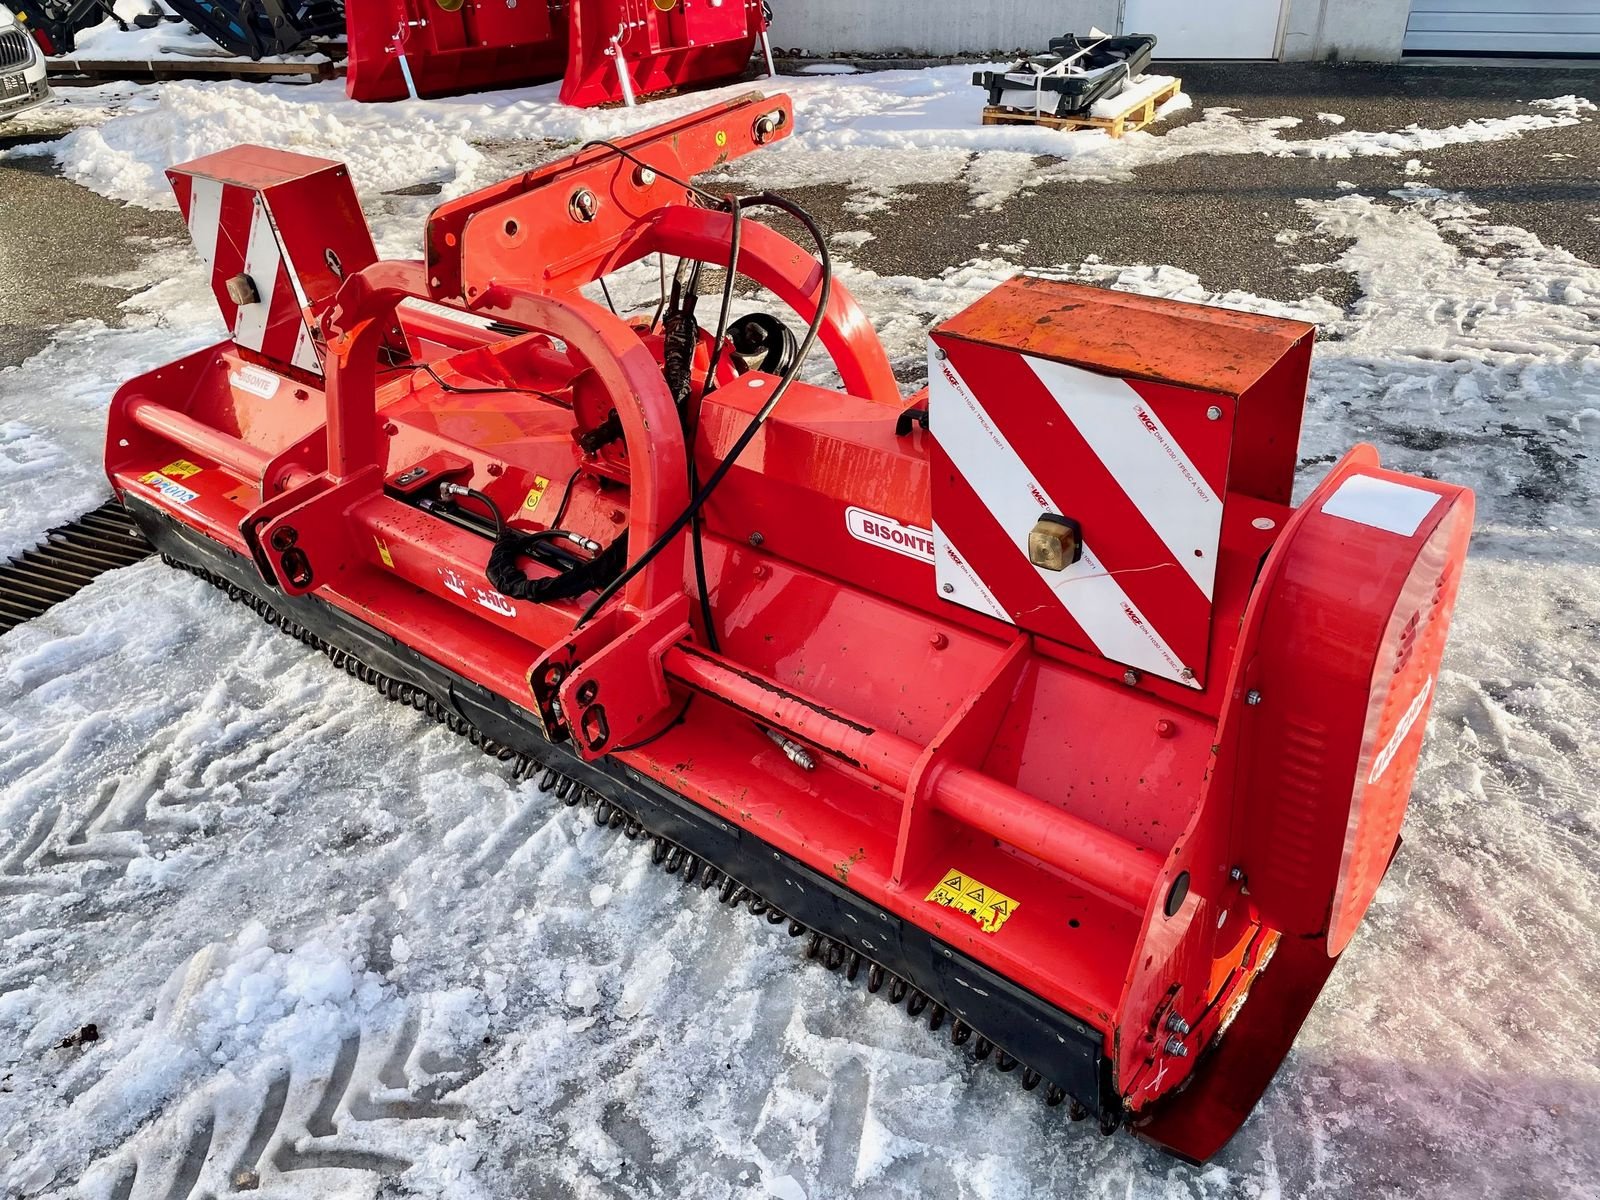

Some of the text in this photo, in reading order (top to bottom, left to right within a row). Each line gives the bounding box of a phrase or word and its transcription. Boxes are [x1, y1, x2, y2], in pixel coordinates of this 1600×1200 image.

[943, 367, 959, 387] WGF
[956, 385, 965, 396] DIN
[1138, 411, 1158, 432] WGF
[1153, 431, 1164, 443] DIN
[1162, 443, 1177, 459] 11030
[1177, 462, 1194, 482] TPESC
[1196, 486, 1210, 503] 10071
[1032, 488, 1049, 507] WGF
[863, 519, 935, 556] BISONTE
[947, 549, 963, 566] WGF
[1124, 607, 1143, 627] WGF
[1140, 625, 1148, 635] DIN
[1148, 634, 1161, 649] 11030
